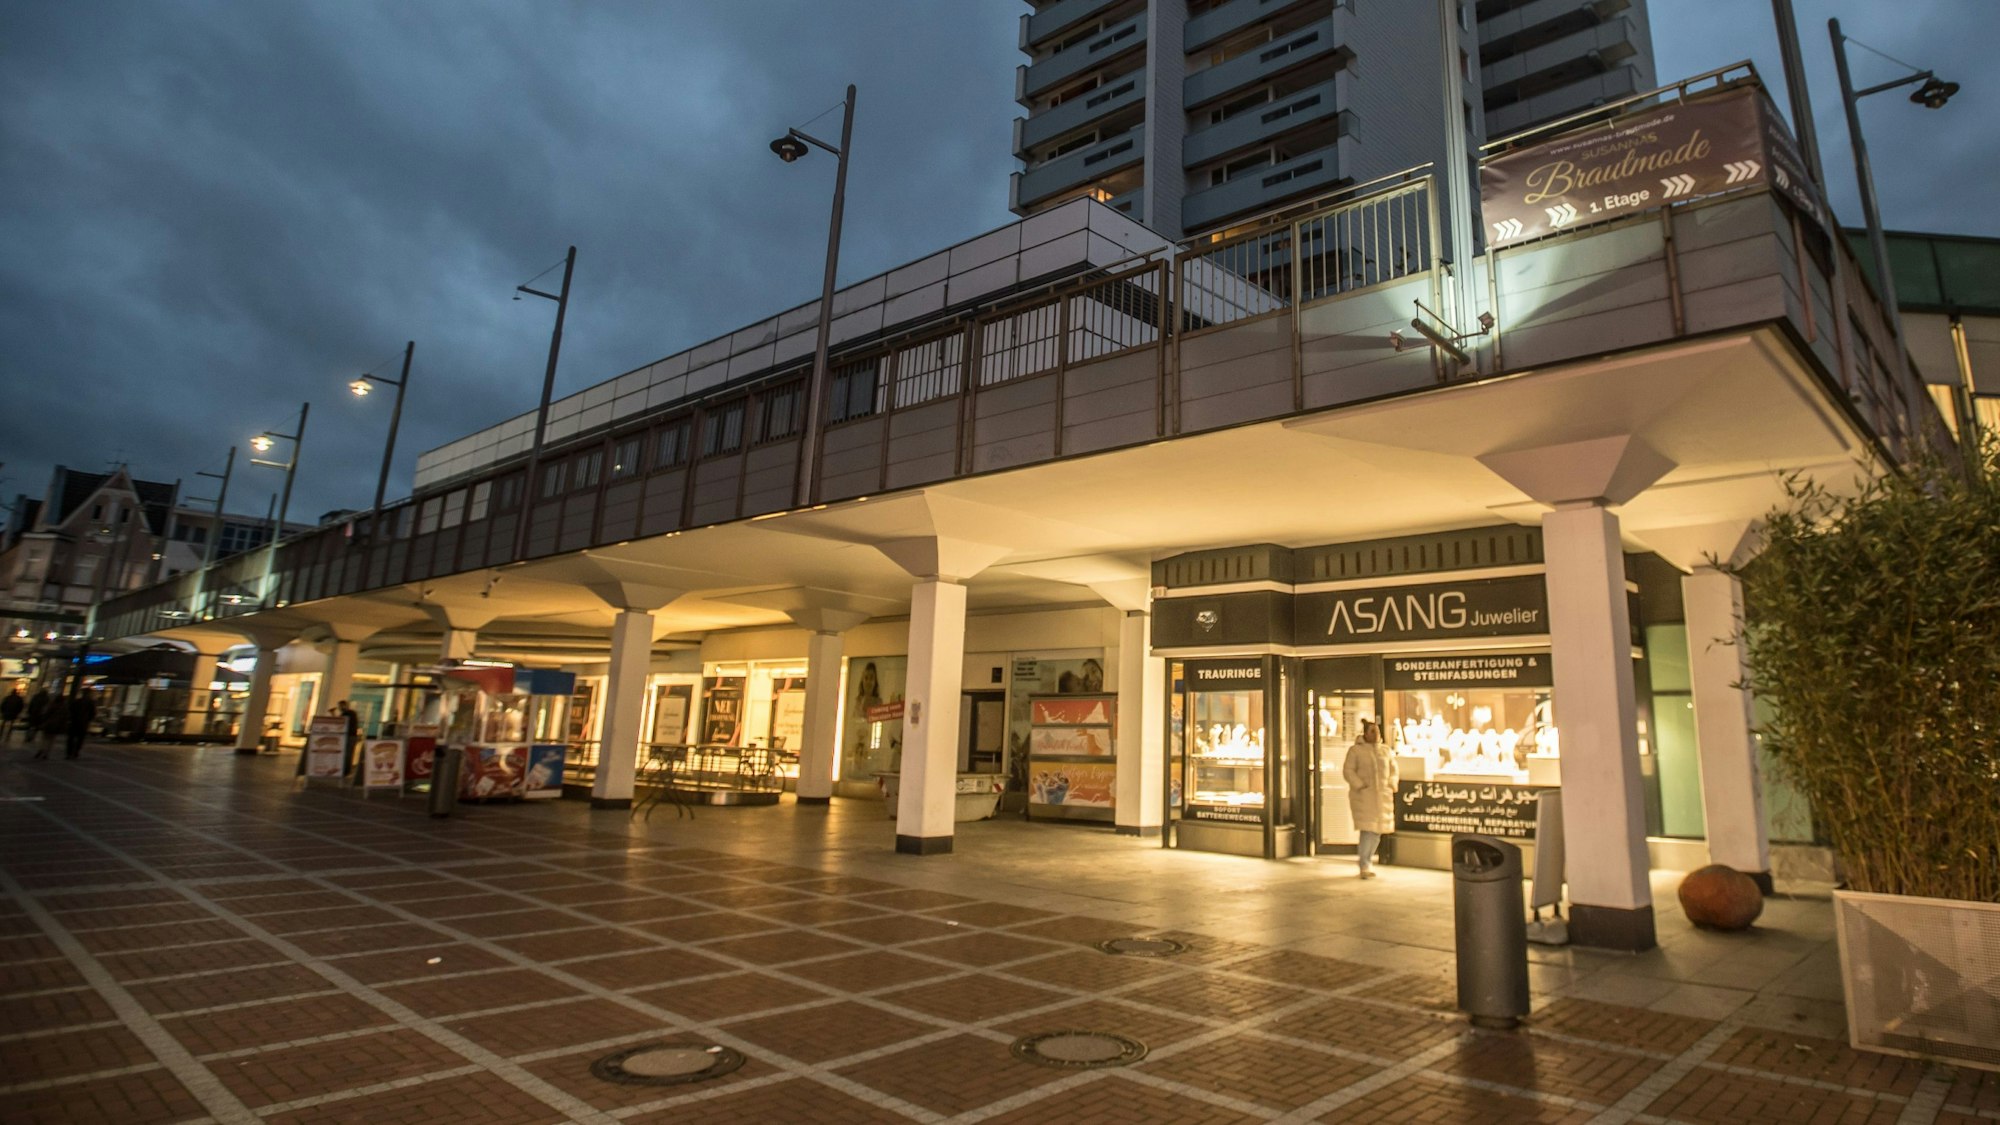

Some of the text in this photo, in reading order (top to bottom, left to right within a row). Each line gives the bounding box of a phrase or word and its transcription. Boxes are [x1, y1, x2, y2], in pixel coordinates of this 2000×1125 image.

[1581, 132, 1658, 160] SUSANNAS
[1524, 129, 1711, 204] Brautmode
[1589, 189, 1650, 214] 1. Etage
[1327, 591, 1539, 636] ASANG Juwelier
[1395, 656, 1538, 671] SONDERANFERTIGUNG &
[1197, 668, 1262, 680] TRAURINGE
[1413, 668, 1518, 681] STEINFASSUNGEN
[1428, 824, 1527, 837] GRAVUREN ALLER ART
